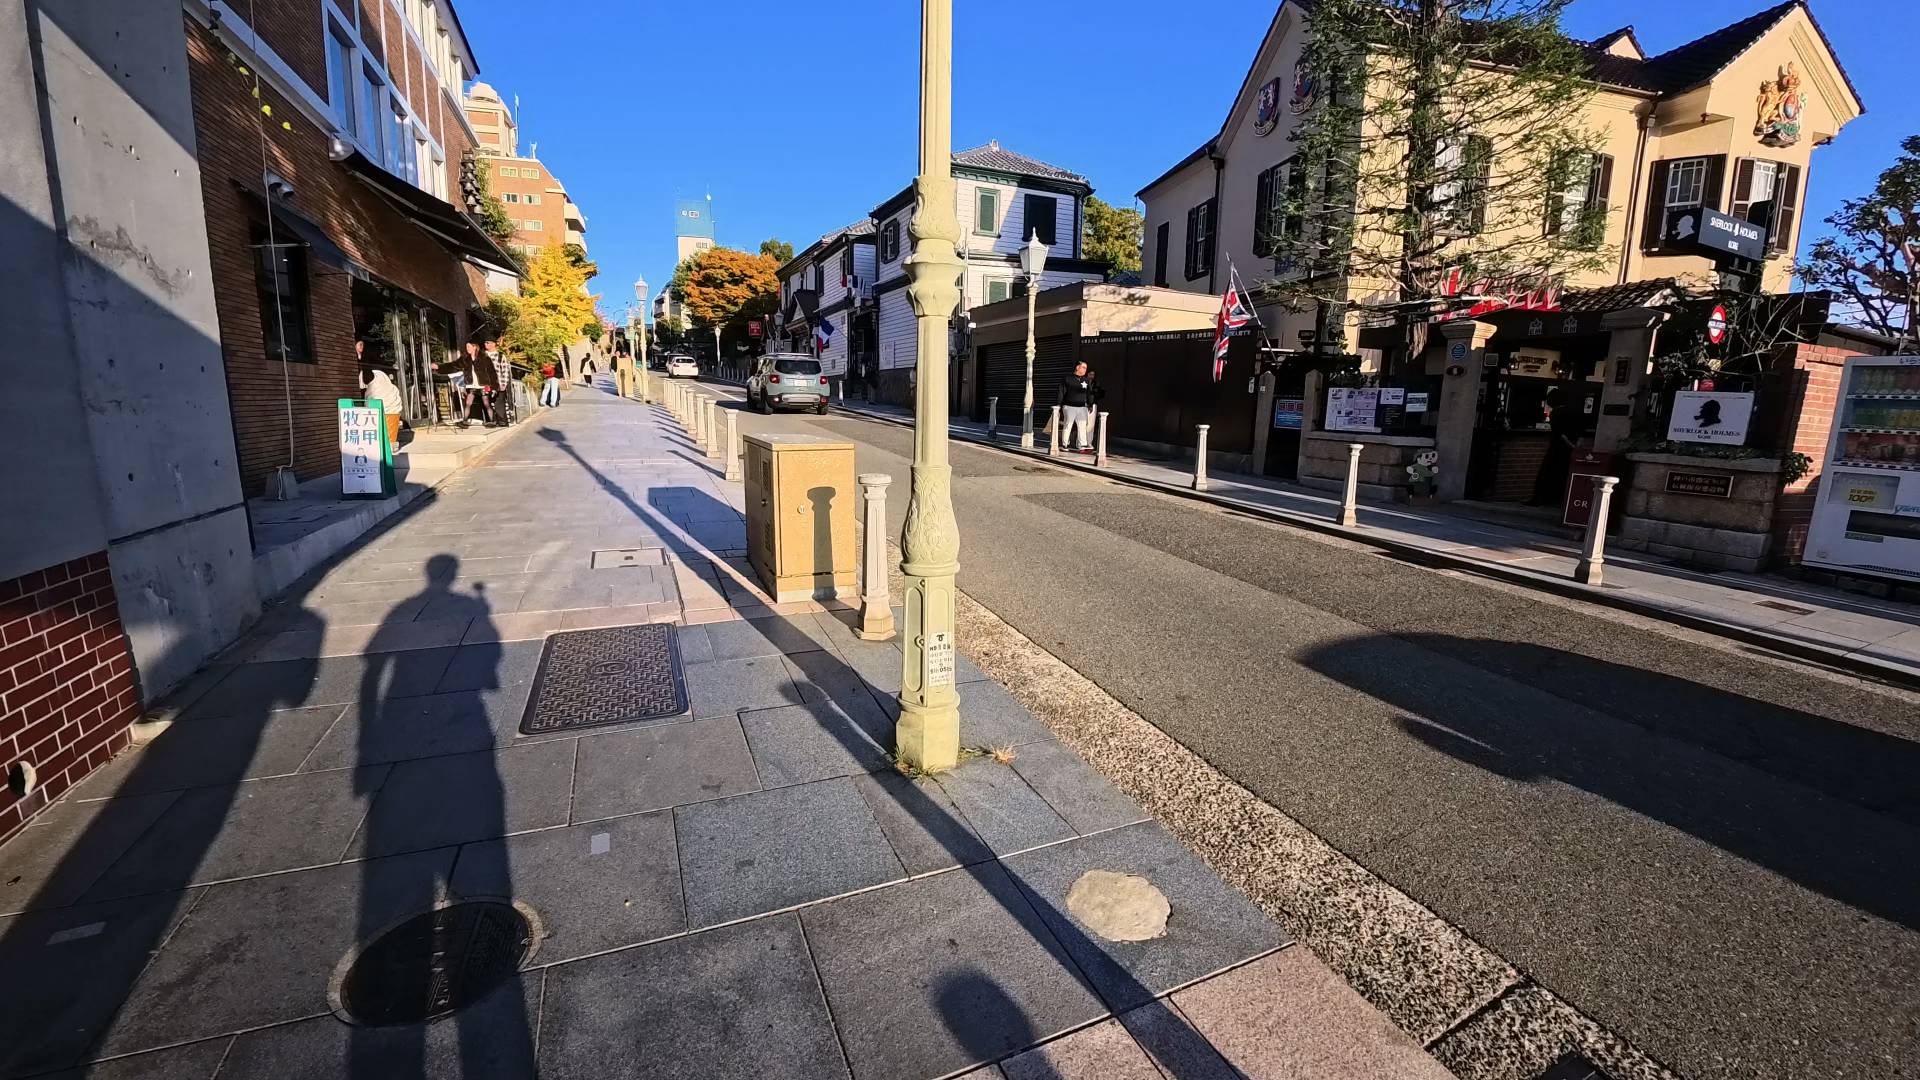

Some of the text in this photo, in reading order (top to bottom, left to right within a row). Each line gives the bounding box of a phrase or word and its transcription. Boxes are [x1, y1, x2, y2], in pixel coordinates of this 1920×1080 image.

[1711, 217, 1758, 240] SHERLOCK HOLMES
[343, 411, 360, 445] 牧場
[363, 411, 377, 445] 六甲
[1673, 427, 1741, 437] SHERLOCK HOLMES
